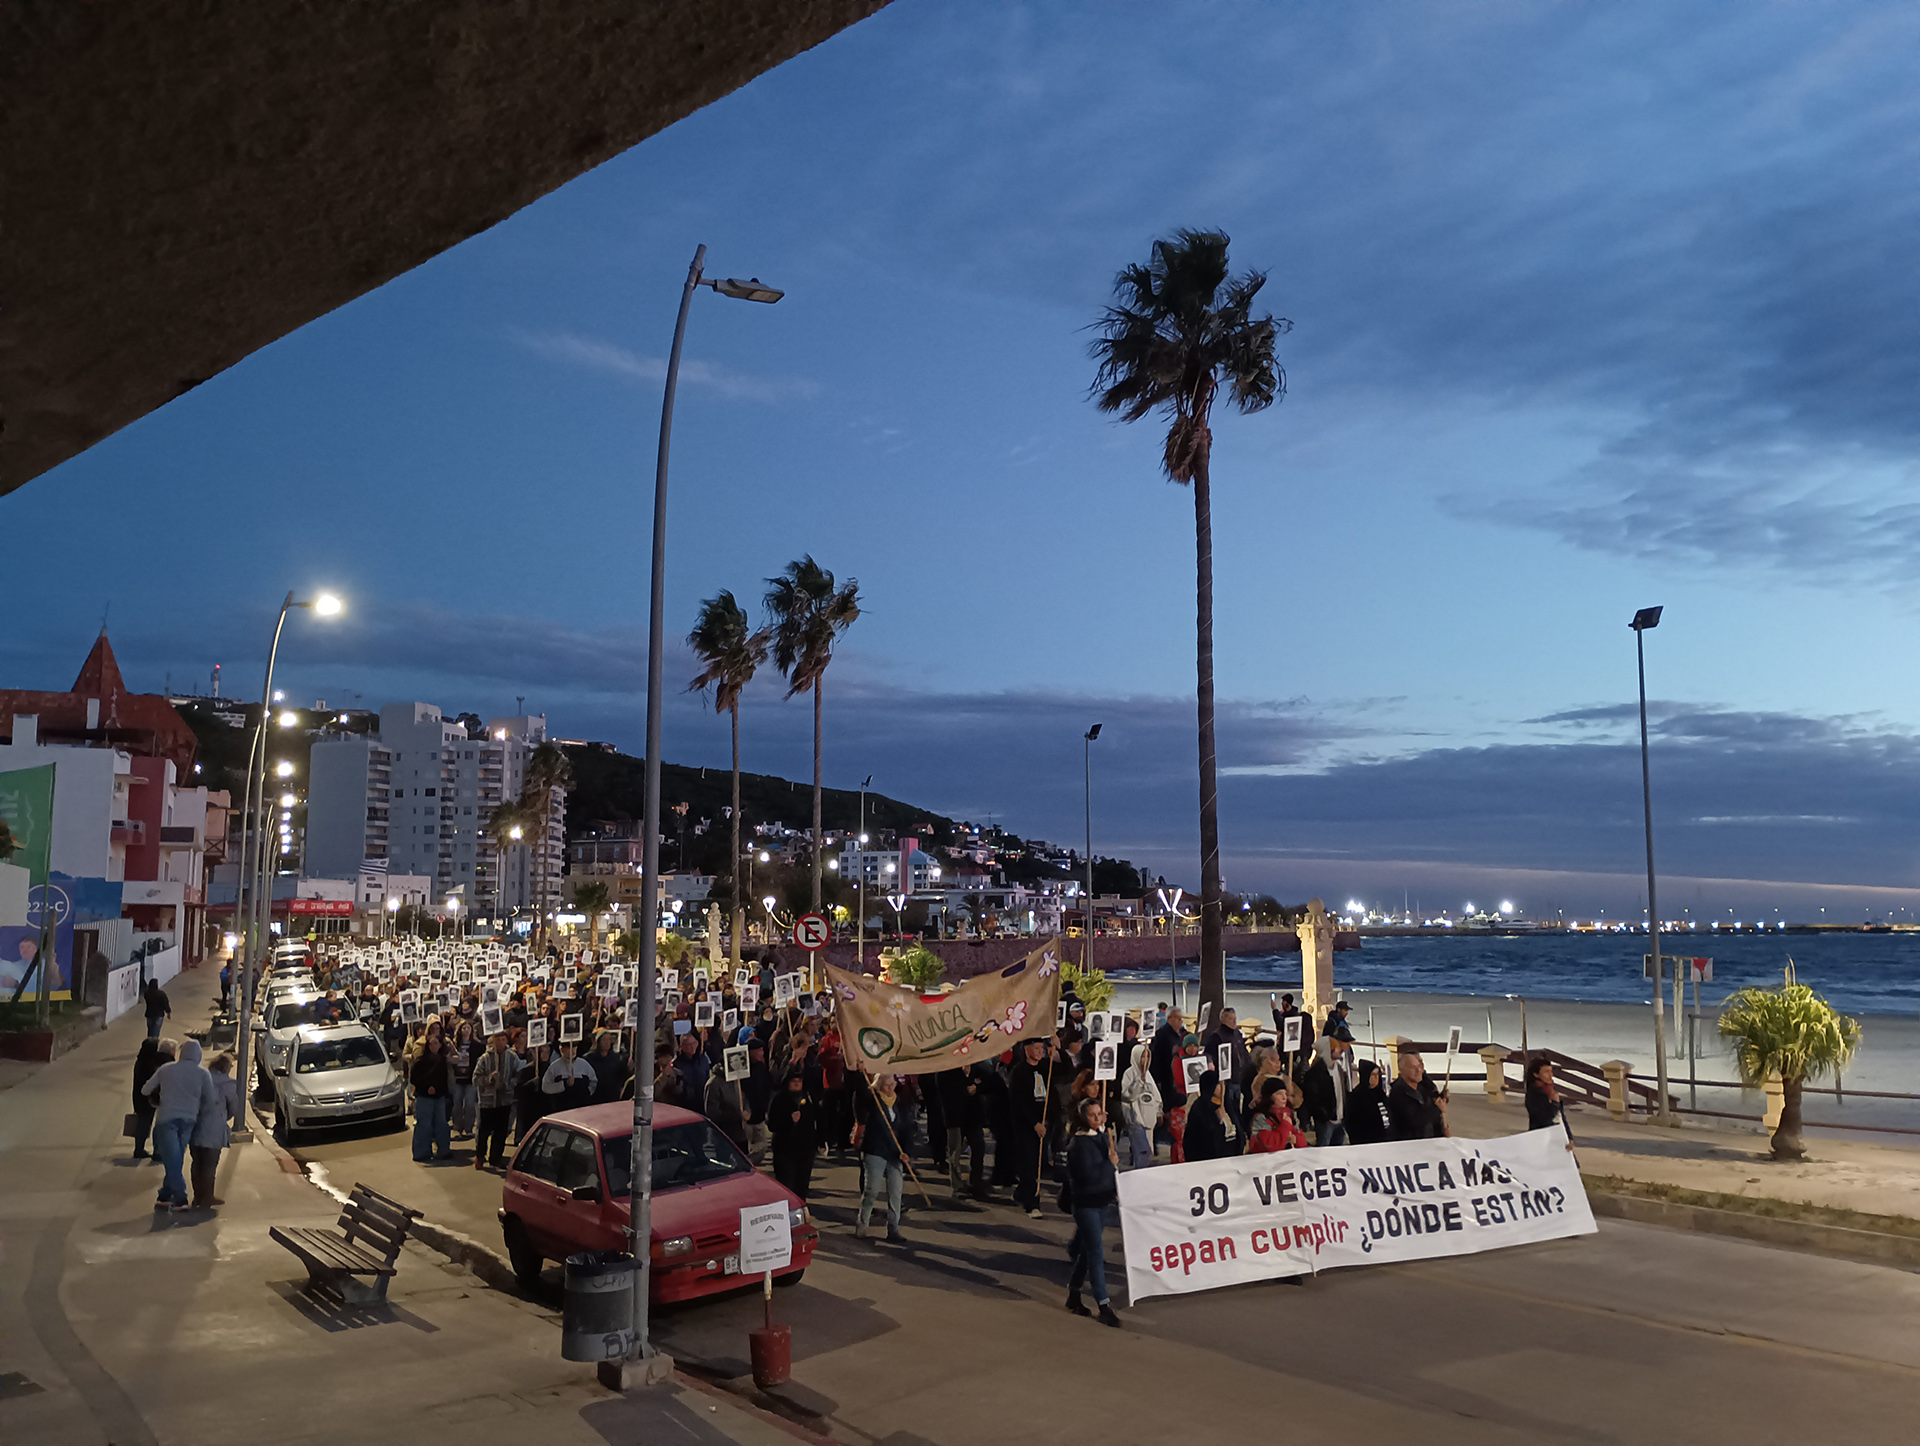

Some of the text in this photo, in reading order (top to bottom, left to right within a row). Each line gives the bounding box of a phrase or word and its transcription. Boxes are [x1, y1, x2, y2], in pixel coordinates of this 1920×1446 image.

[907, 1003, 972, 1046] NUNCA
[1189, 1183, 1230, 1217] 30
[1253, 1168, 1348, 1206] VECES
[1359, 1159, 1456, 1195] NUNCA
[750, 1213, 785, 1227] RESERVADO
[1150, 1183, 1565, 1275] sepan cumplir ¿DÓNDE ESTÁN?
